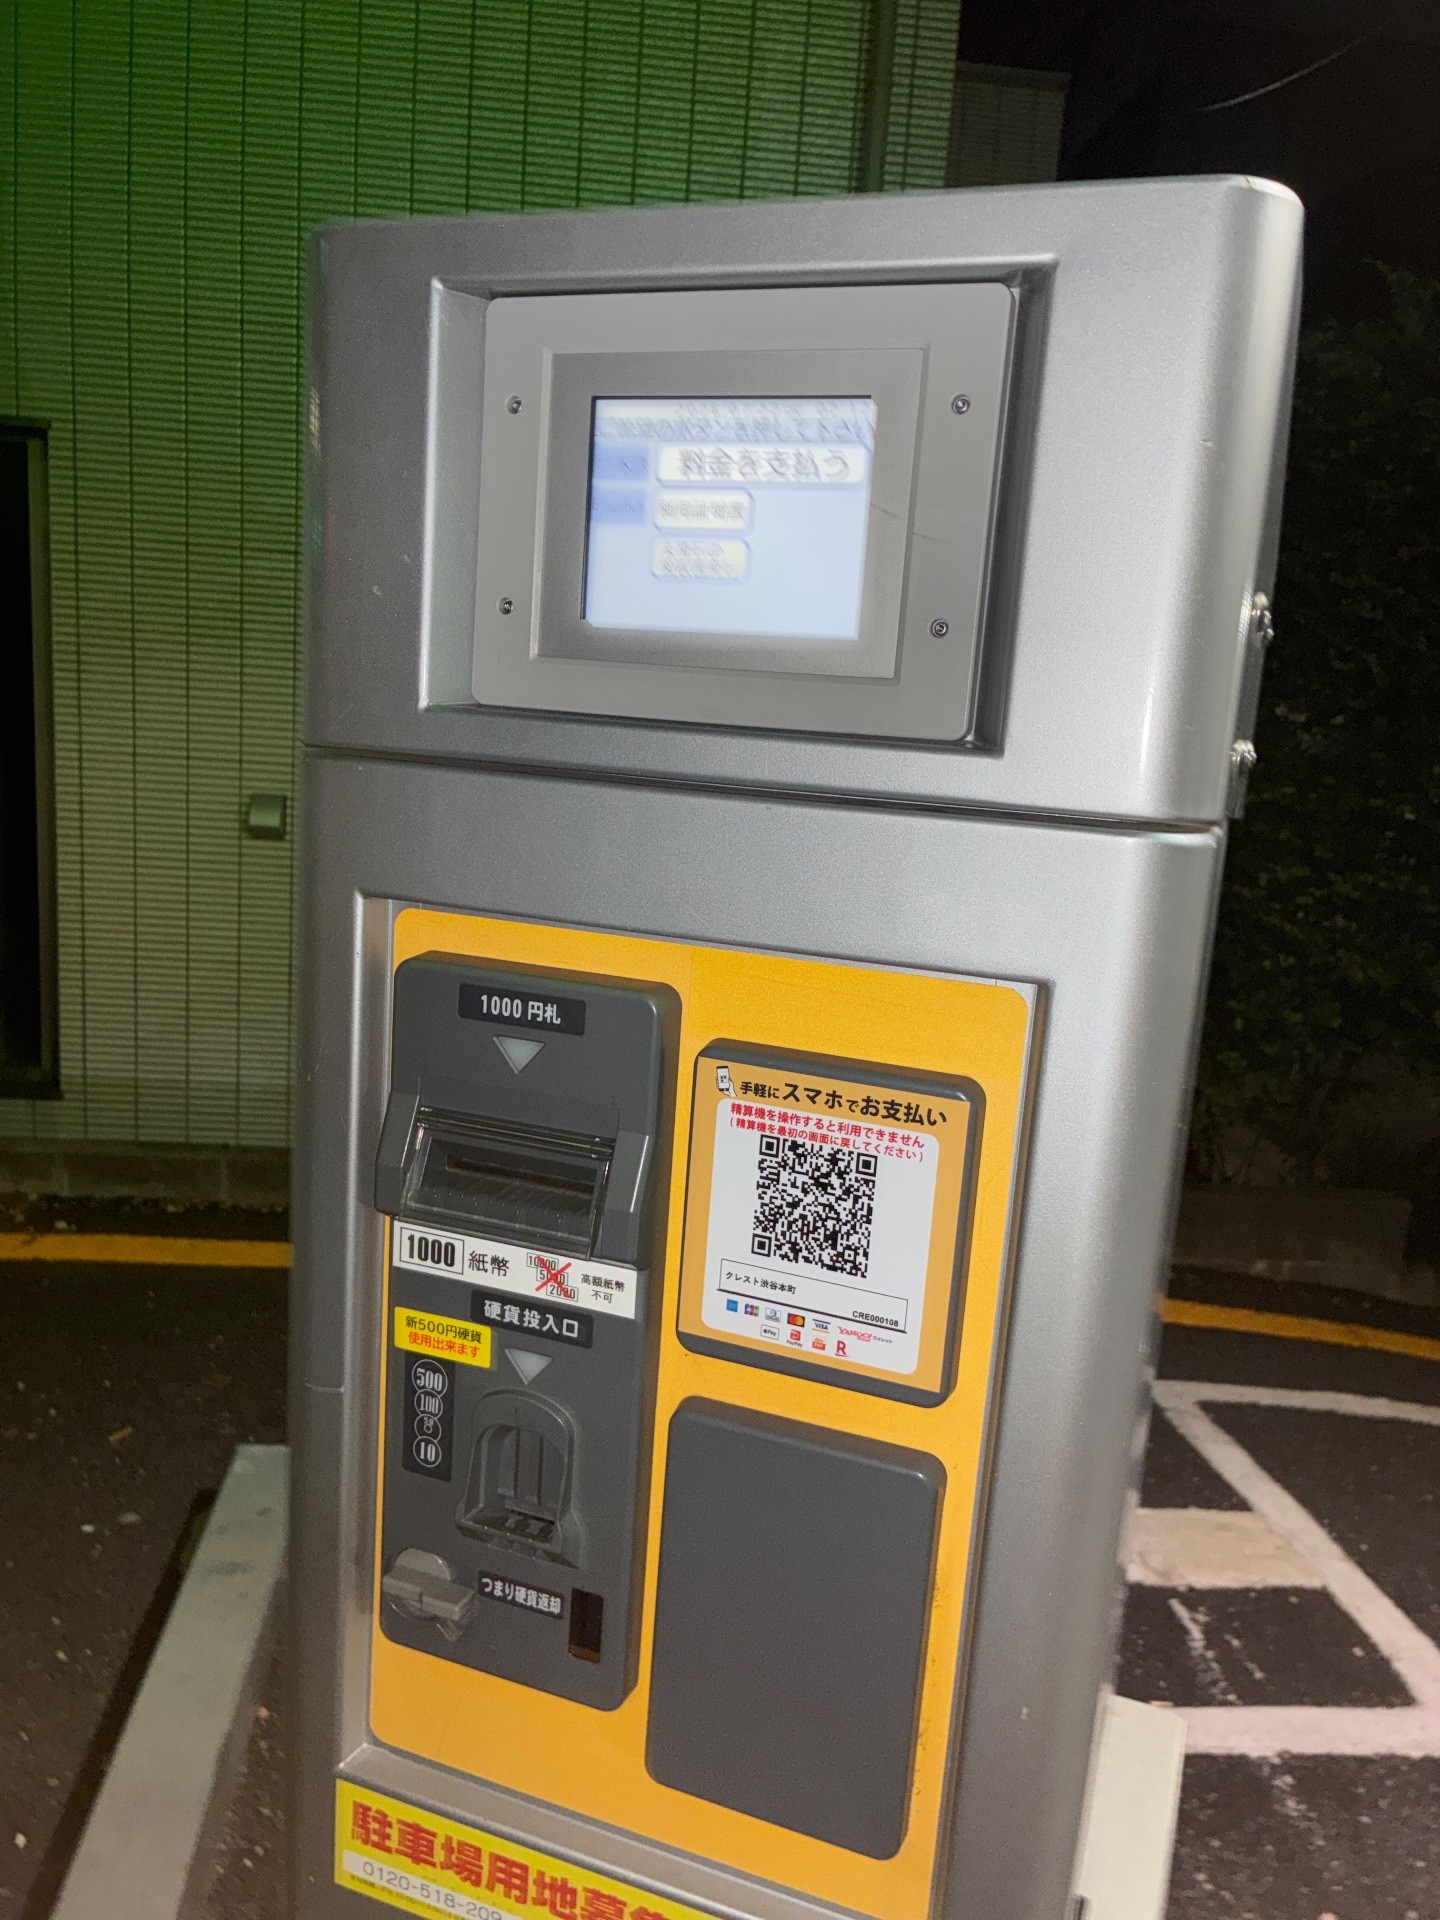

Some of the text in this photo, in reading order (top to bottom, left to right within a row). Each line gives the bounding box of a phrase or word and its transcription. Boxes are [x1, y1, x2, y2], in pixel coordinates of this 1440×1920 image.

[740, 1081, 948, 1127] 手軽にスマホでお支払い
[730, 1102, 925, 1149] 精算機を操作すると利用できません
[407, 1234, 510, 1277] 1000 紙幣
[539, 1269, 566, 1286] 50
[581, 1273, 626, 1293] 高額紙幣
[725, 1271, 797, 1295] クレスト渋谷本町
[591, 1289, 614, 1304] 不可
[405, 1315, 482, 1345] 新500円硬貨
[483, 1300, 579, 1338] 硬貨投入口
[852, 1310, 899, 1327] CRE000108
[408, 1332, 481, 1358] 使用出来ます
[836, 1339, 848, 1356] R
[416, 1367, 443, 1392] 500
[419, 1393, 439, 1415] 100
[420, 1441, 436, 1463] 10
[481, 1577, 562, 1615] つまり硬貨返却
[352, 1800, 672, 1920] 駐車場用地募
